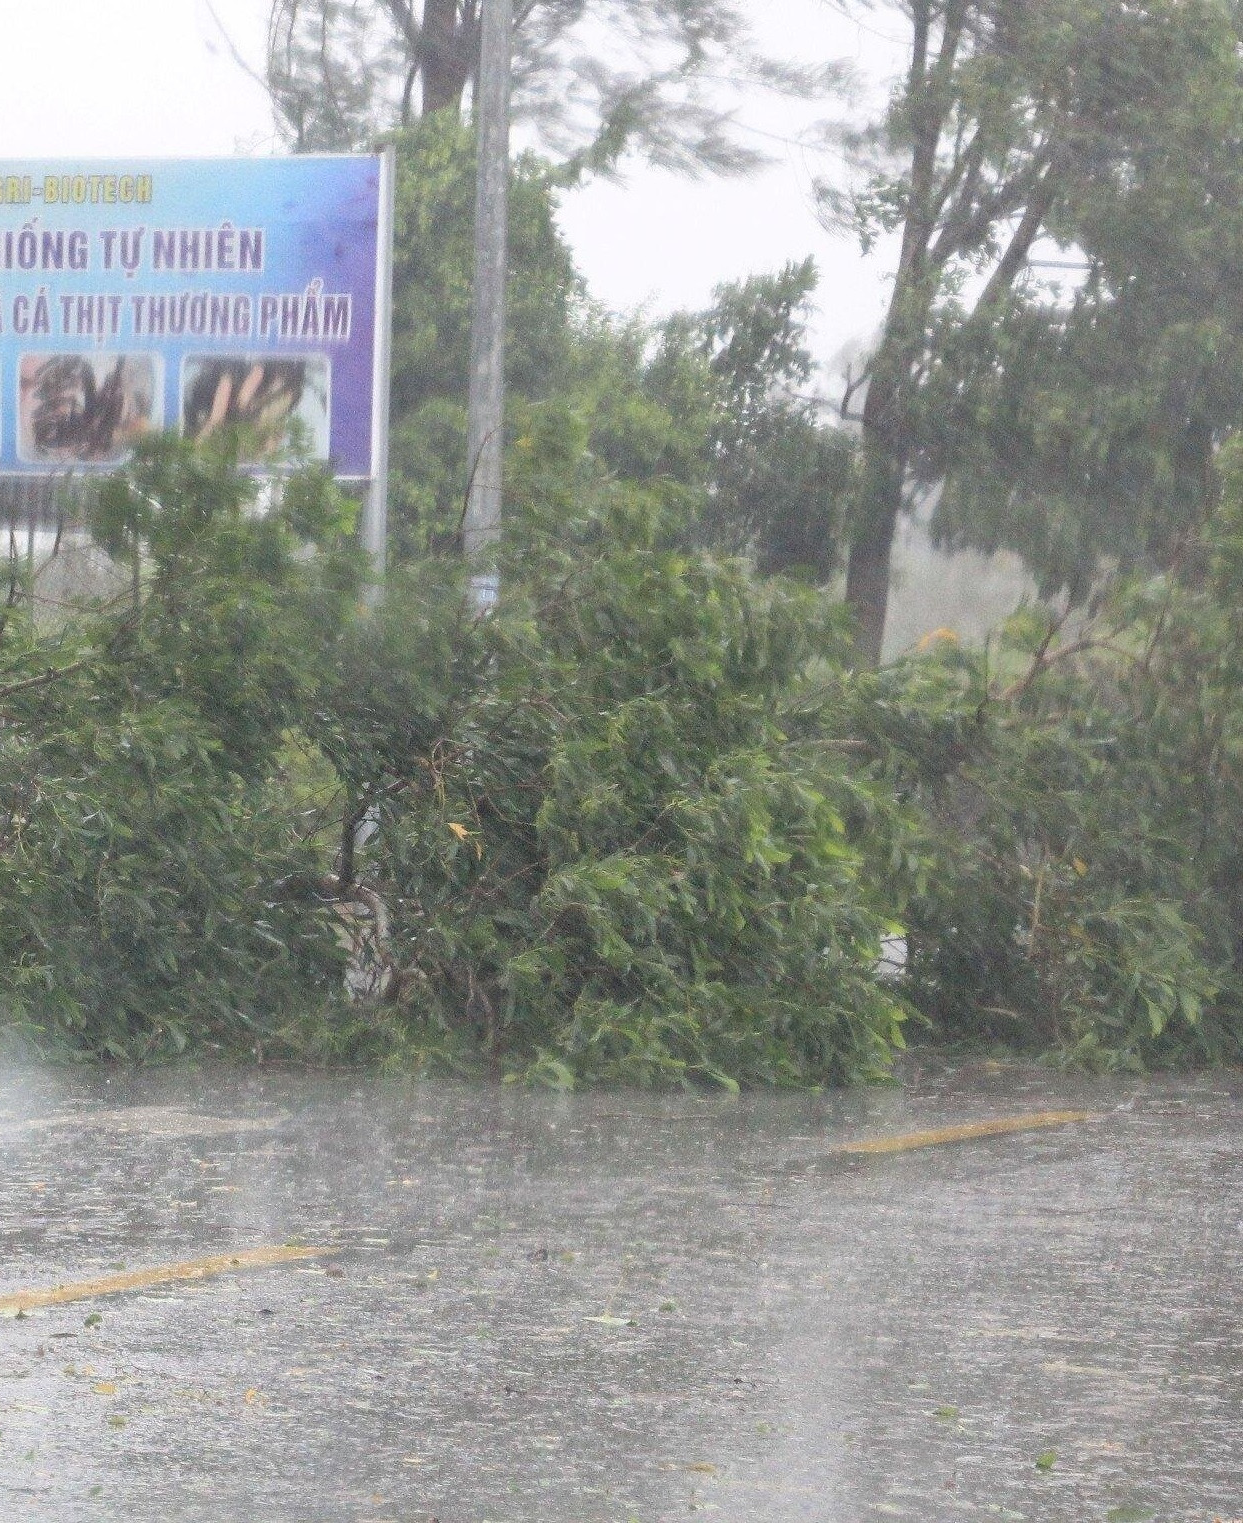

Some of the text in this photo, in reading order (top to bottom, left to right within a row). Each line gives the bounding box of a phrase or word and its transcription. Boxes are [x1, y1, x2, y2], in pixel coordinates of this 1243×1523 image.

[99, 226, 146, 279] TỰ
[152, 221, 263, 270] NHIÊN
[13, 286, 50, 333] CÁ
[60, 295, 121, 343] THỊT
[131, 290, 252, 335] THƯƠNG
[259, 276, 351, 336] PHẨM
